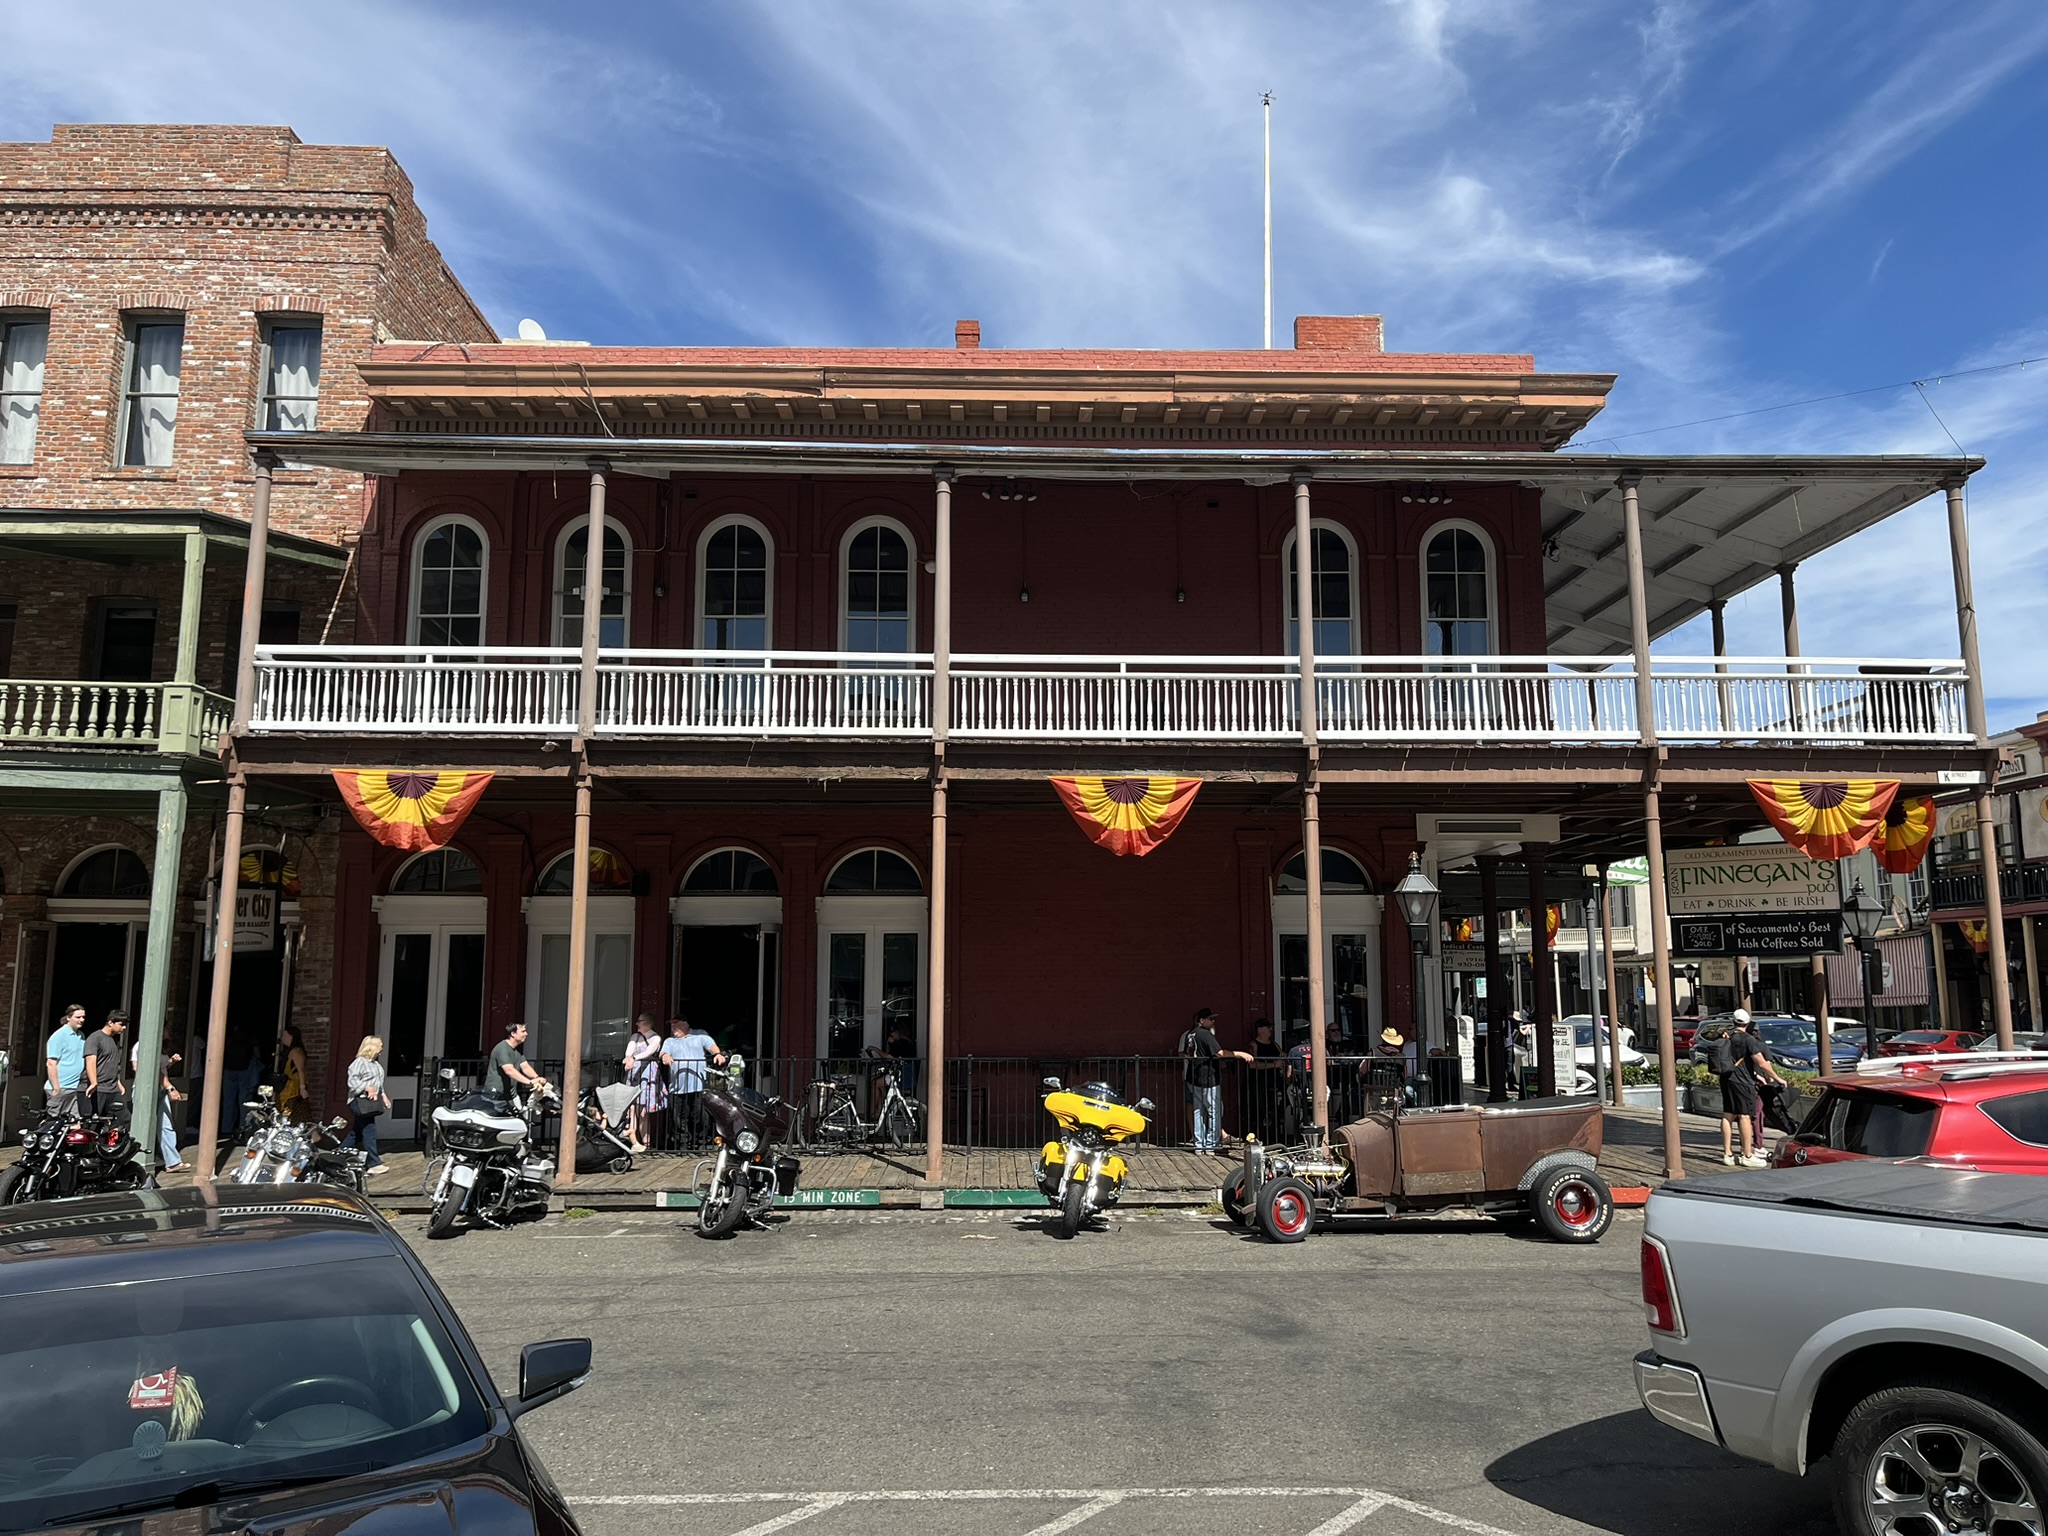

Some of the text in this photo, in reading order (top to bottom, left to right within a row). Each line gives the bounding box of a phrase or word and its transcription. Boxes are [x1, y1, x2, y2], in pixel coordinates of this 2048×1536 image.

[1944, 773, 1951, 782] K
[1701, 849, 1757, 858] SACRAMENTO
[1758, 847, 1801, 855] WATERFRO
[1670, 867, 1680, 895] SEAN
[1806, 880, 1836, 896] pub
[252, 894, 271, 919] City
[1683, 896, 1825, 910] EAT DRINK BE IRISH
[1725, 921, 1831, 935] of Sacramento's Best
[1737, 936, 1824, 949] Irish Coffees Sold
[1548, 1174, 1581, 1197] HANKOOK
[802, 1191, 824, 1203] MIN
[830, 1191, 861, 1203] ZONE
[1592, 1204, 1608, 1232] VENTUS
